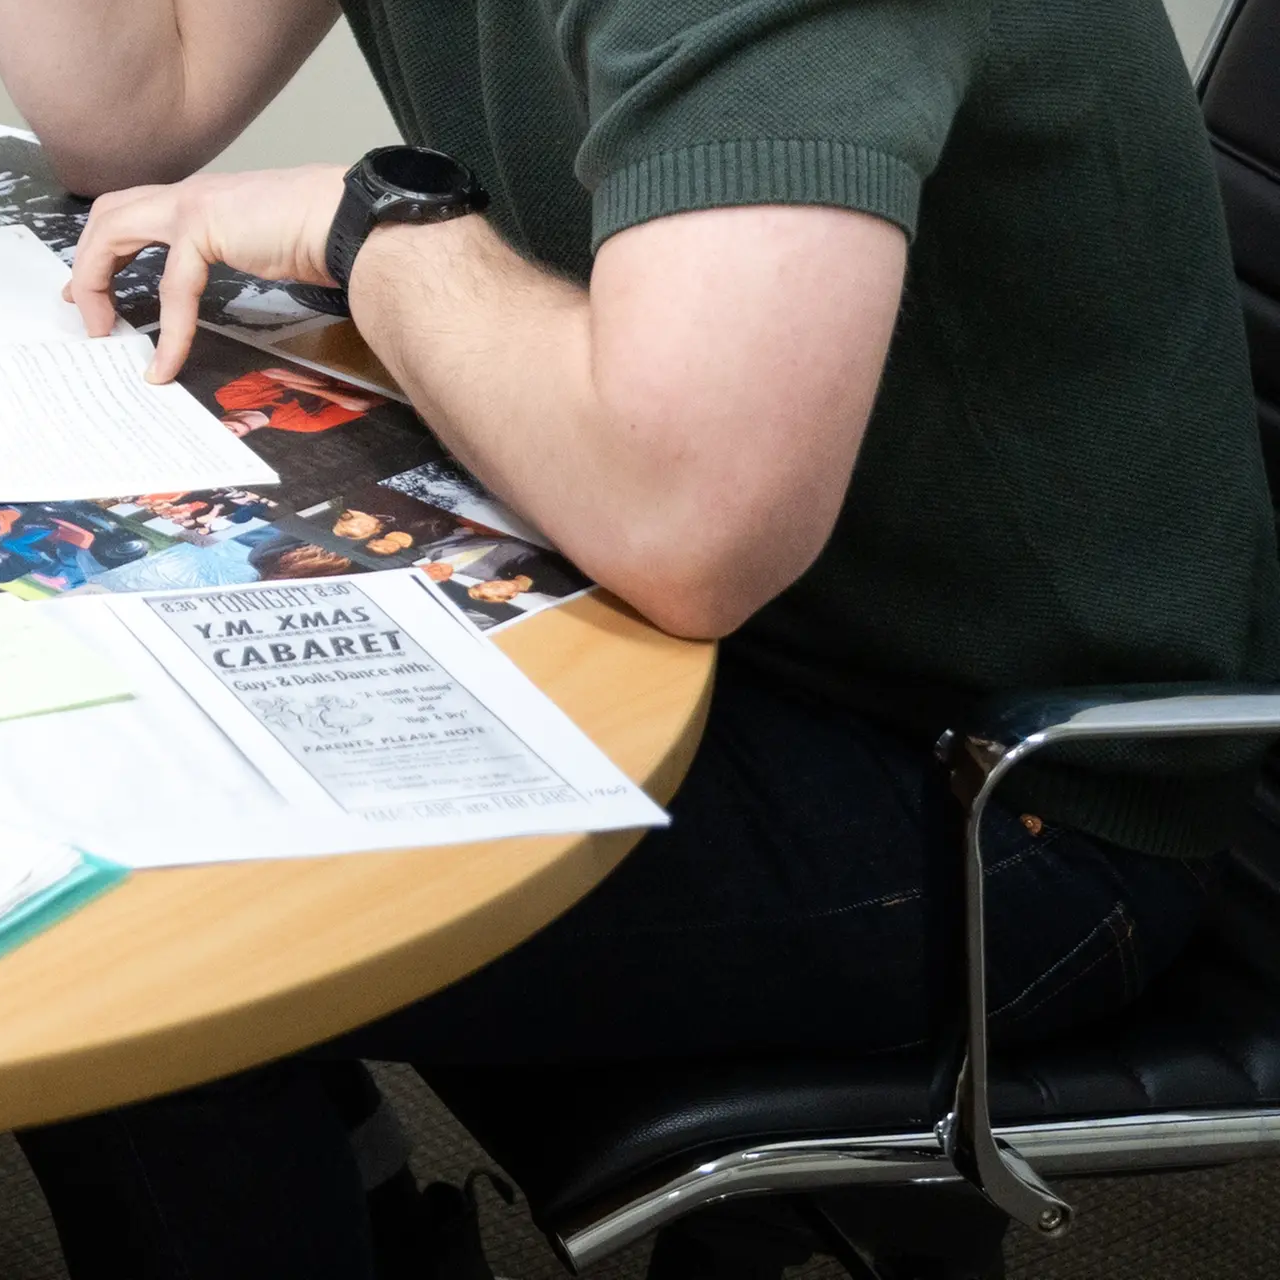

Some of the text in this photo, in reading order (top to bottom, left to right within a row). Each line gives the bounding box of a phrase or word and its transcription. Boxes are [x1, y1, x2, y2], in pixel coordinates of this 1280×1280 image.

[161, 584, 350, 615] 8.30 TONIGHT 8.30
[194, 607, 371, 639] Y.M. XMAS
[213, 630, 403, 669] CABARET
[233, 677, 277, 692] Guys
[279, 676, 292, 687] &
[292, 671, 335, 687] Dolls
[338, 667, 388, 682] Dance
[303, 739, 374, 753] PARENTS
[380, 731, 438, 744] PLEASE
[444, 726, 487, 737] NOTE
